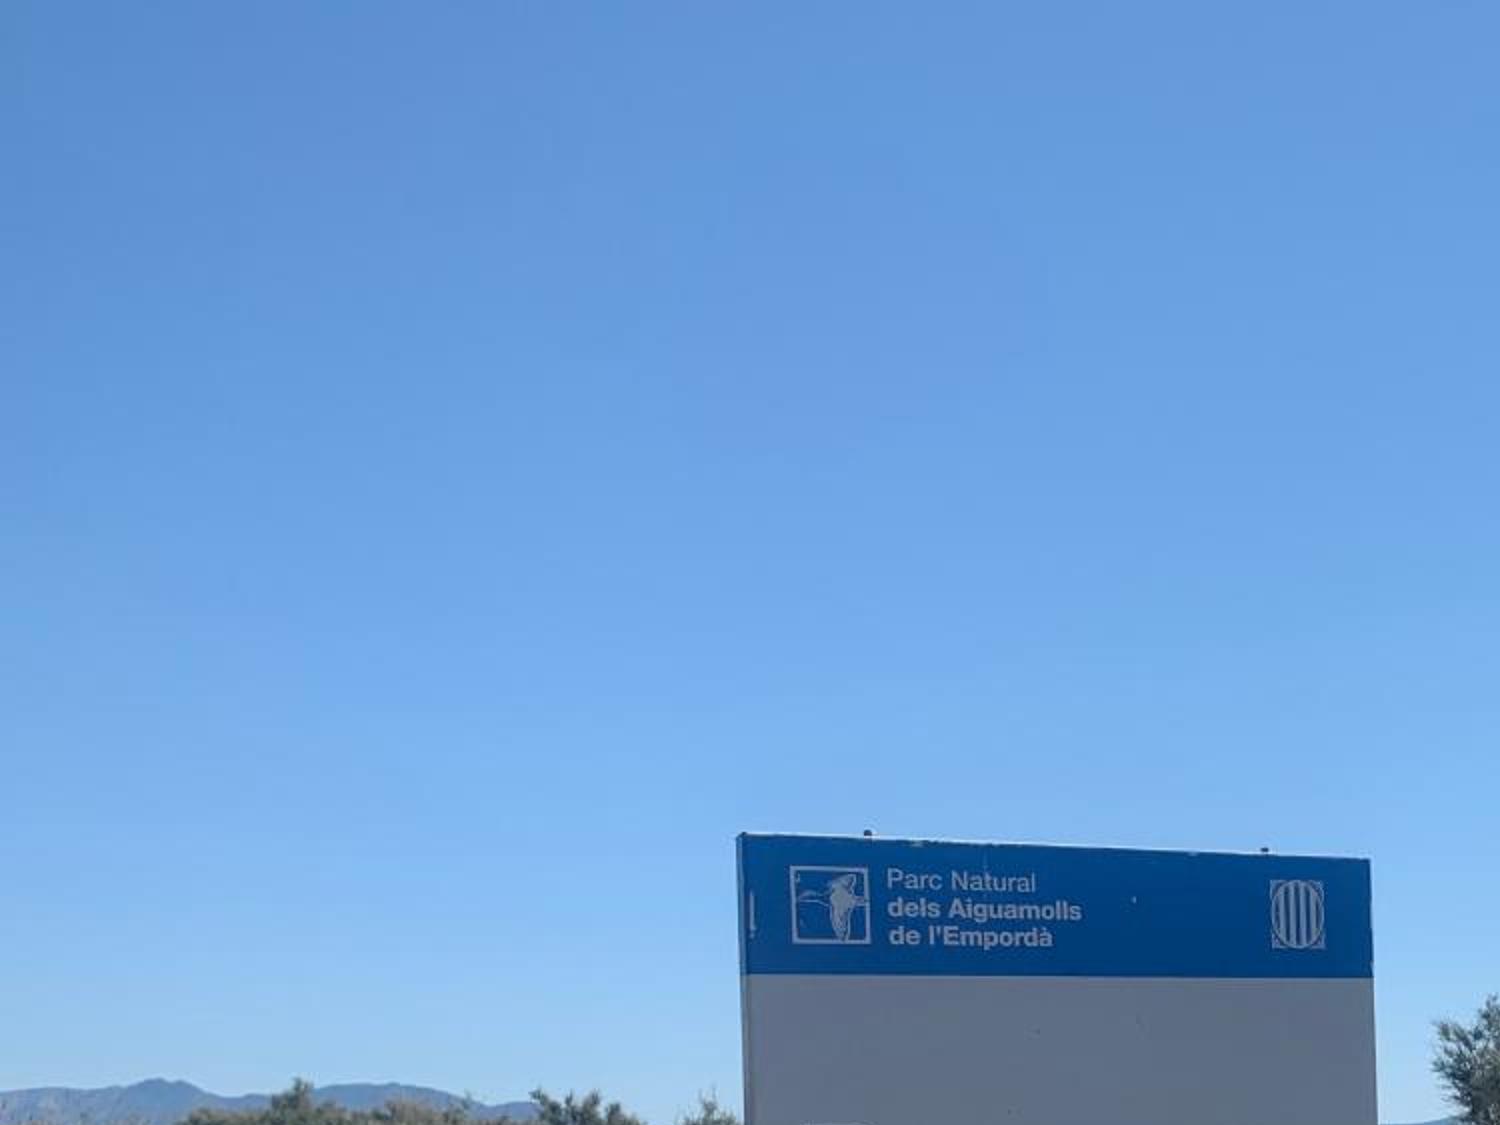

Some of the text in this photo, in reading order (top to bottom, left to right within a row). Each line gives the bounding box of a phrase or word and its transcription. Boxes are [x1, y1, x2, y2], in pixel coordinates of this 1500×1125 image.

[887, 868, 1036, 893] Parc Natural
[887, 897, 1082, 923] dels Aiguamolls
[889, 925, 1053, 950] de l'Empordà
